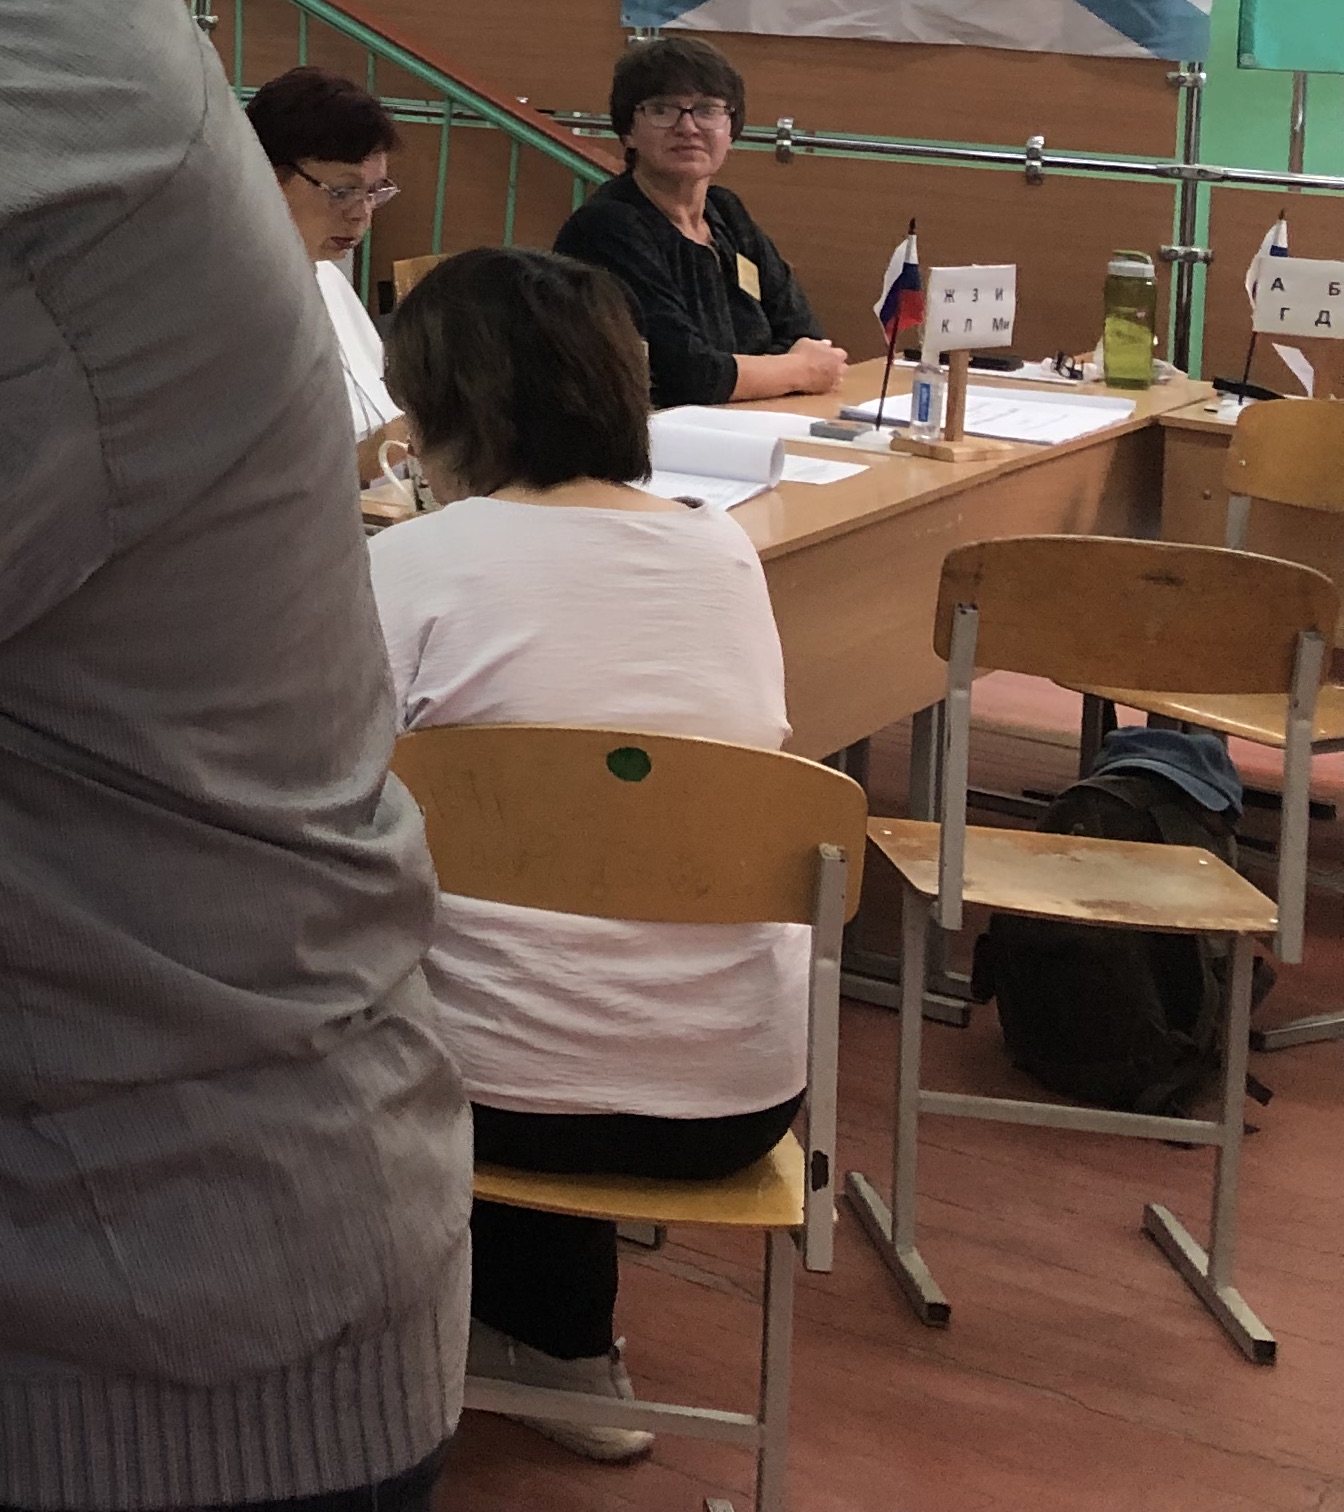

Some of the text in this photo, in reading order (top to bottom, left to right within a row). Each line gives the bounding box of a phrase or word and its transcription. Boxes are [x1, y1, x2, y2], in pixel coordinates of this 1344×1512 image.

[1271, 277, 1341, 296] А Б
[944, 288, 1003, 303] Ж З И
[941, 319, 950, 333] К
[1280, 307, 1331, 328] Г Д
